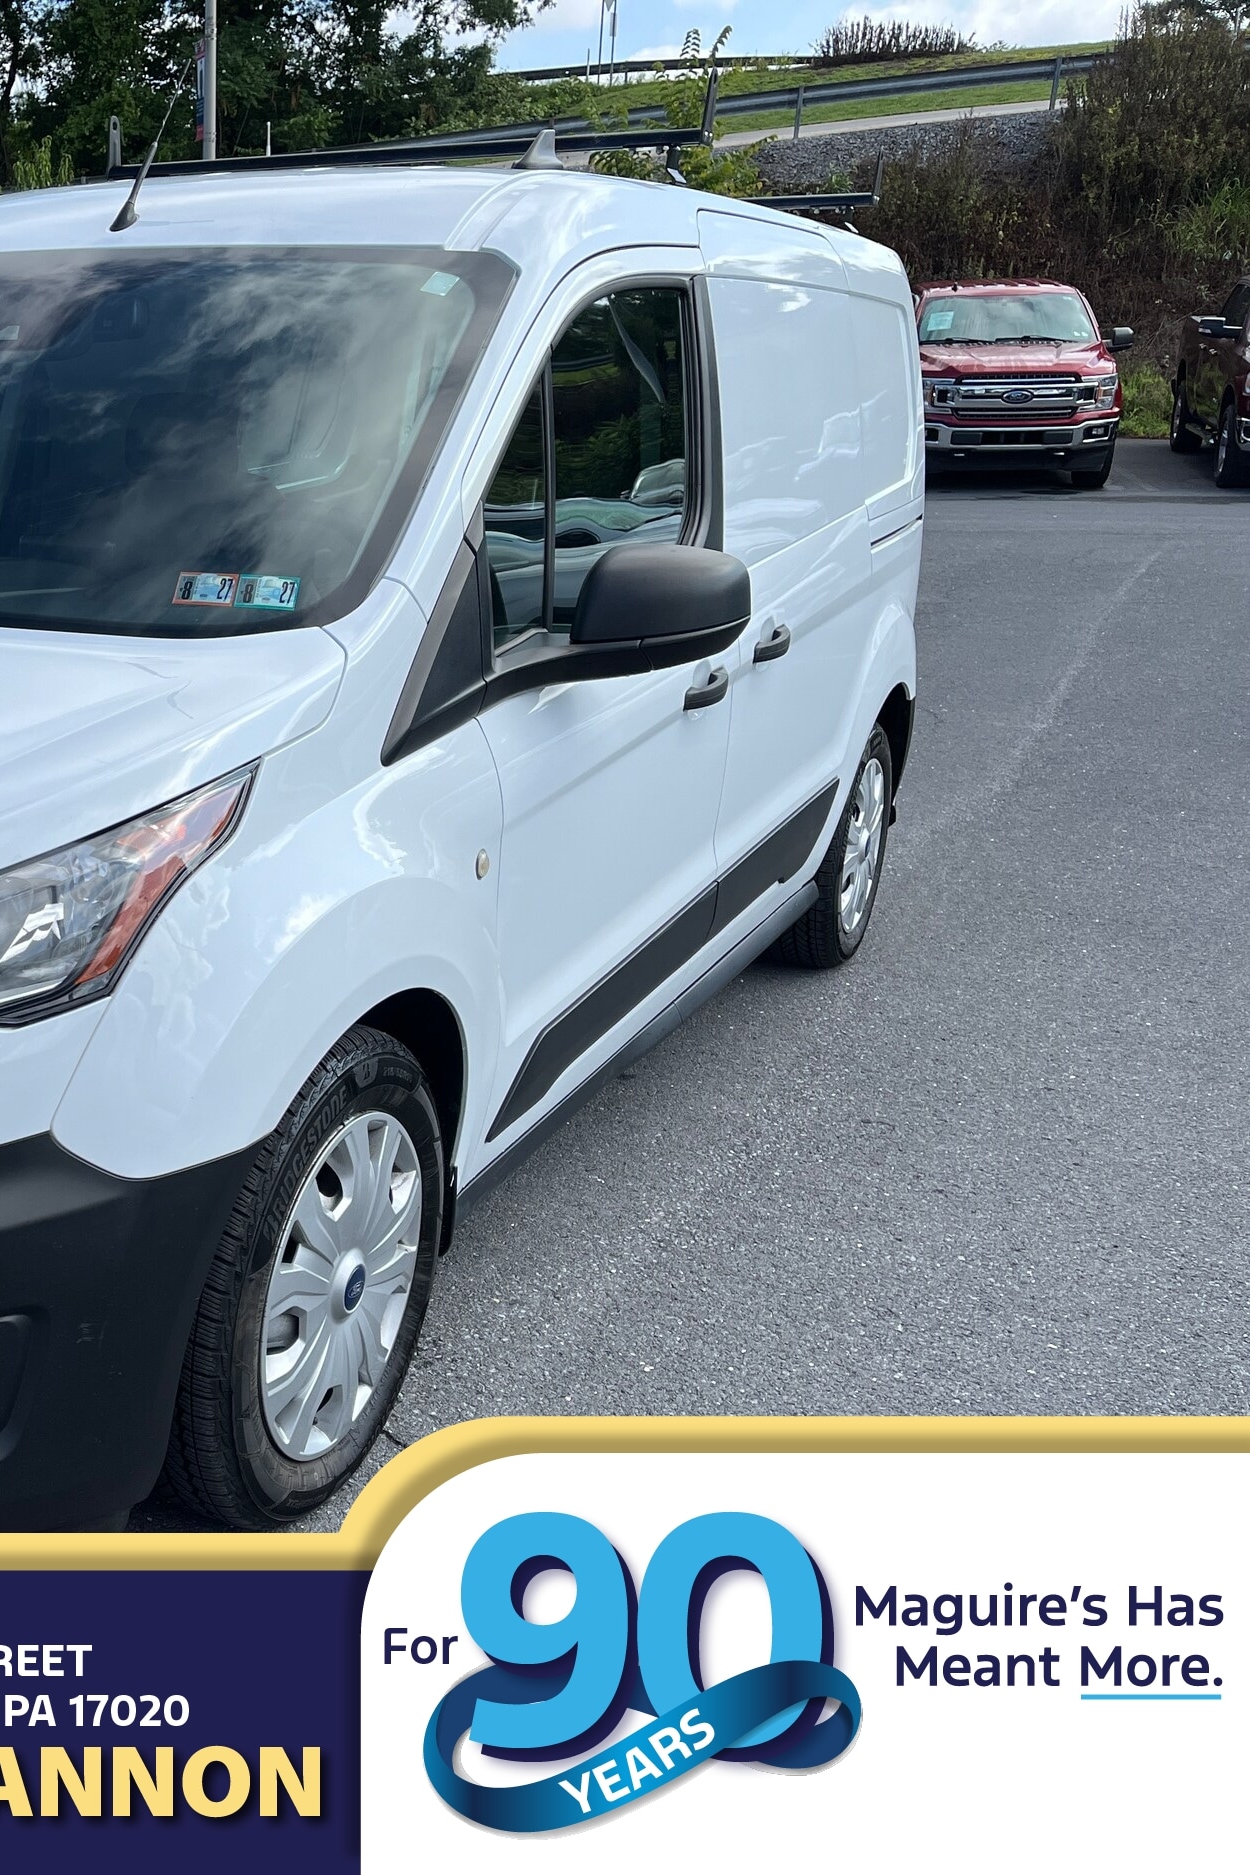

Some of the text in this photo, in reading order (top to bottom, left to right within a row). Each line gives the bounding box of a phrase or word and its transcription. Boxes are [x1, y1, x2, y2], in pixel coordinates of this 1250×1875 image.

[181, 581, 193, 600] 8
[216, 577, 234, 602] 27
[243, 583, 254, 603] 8
[279, 581, 296, 605] 27
[263, 1084, 349, 1241] BRIDGESTONE
